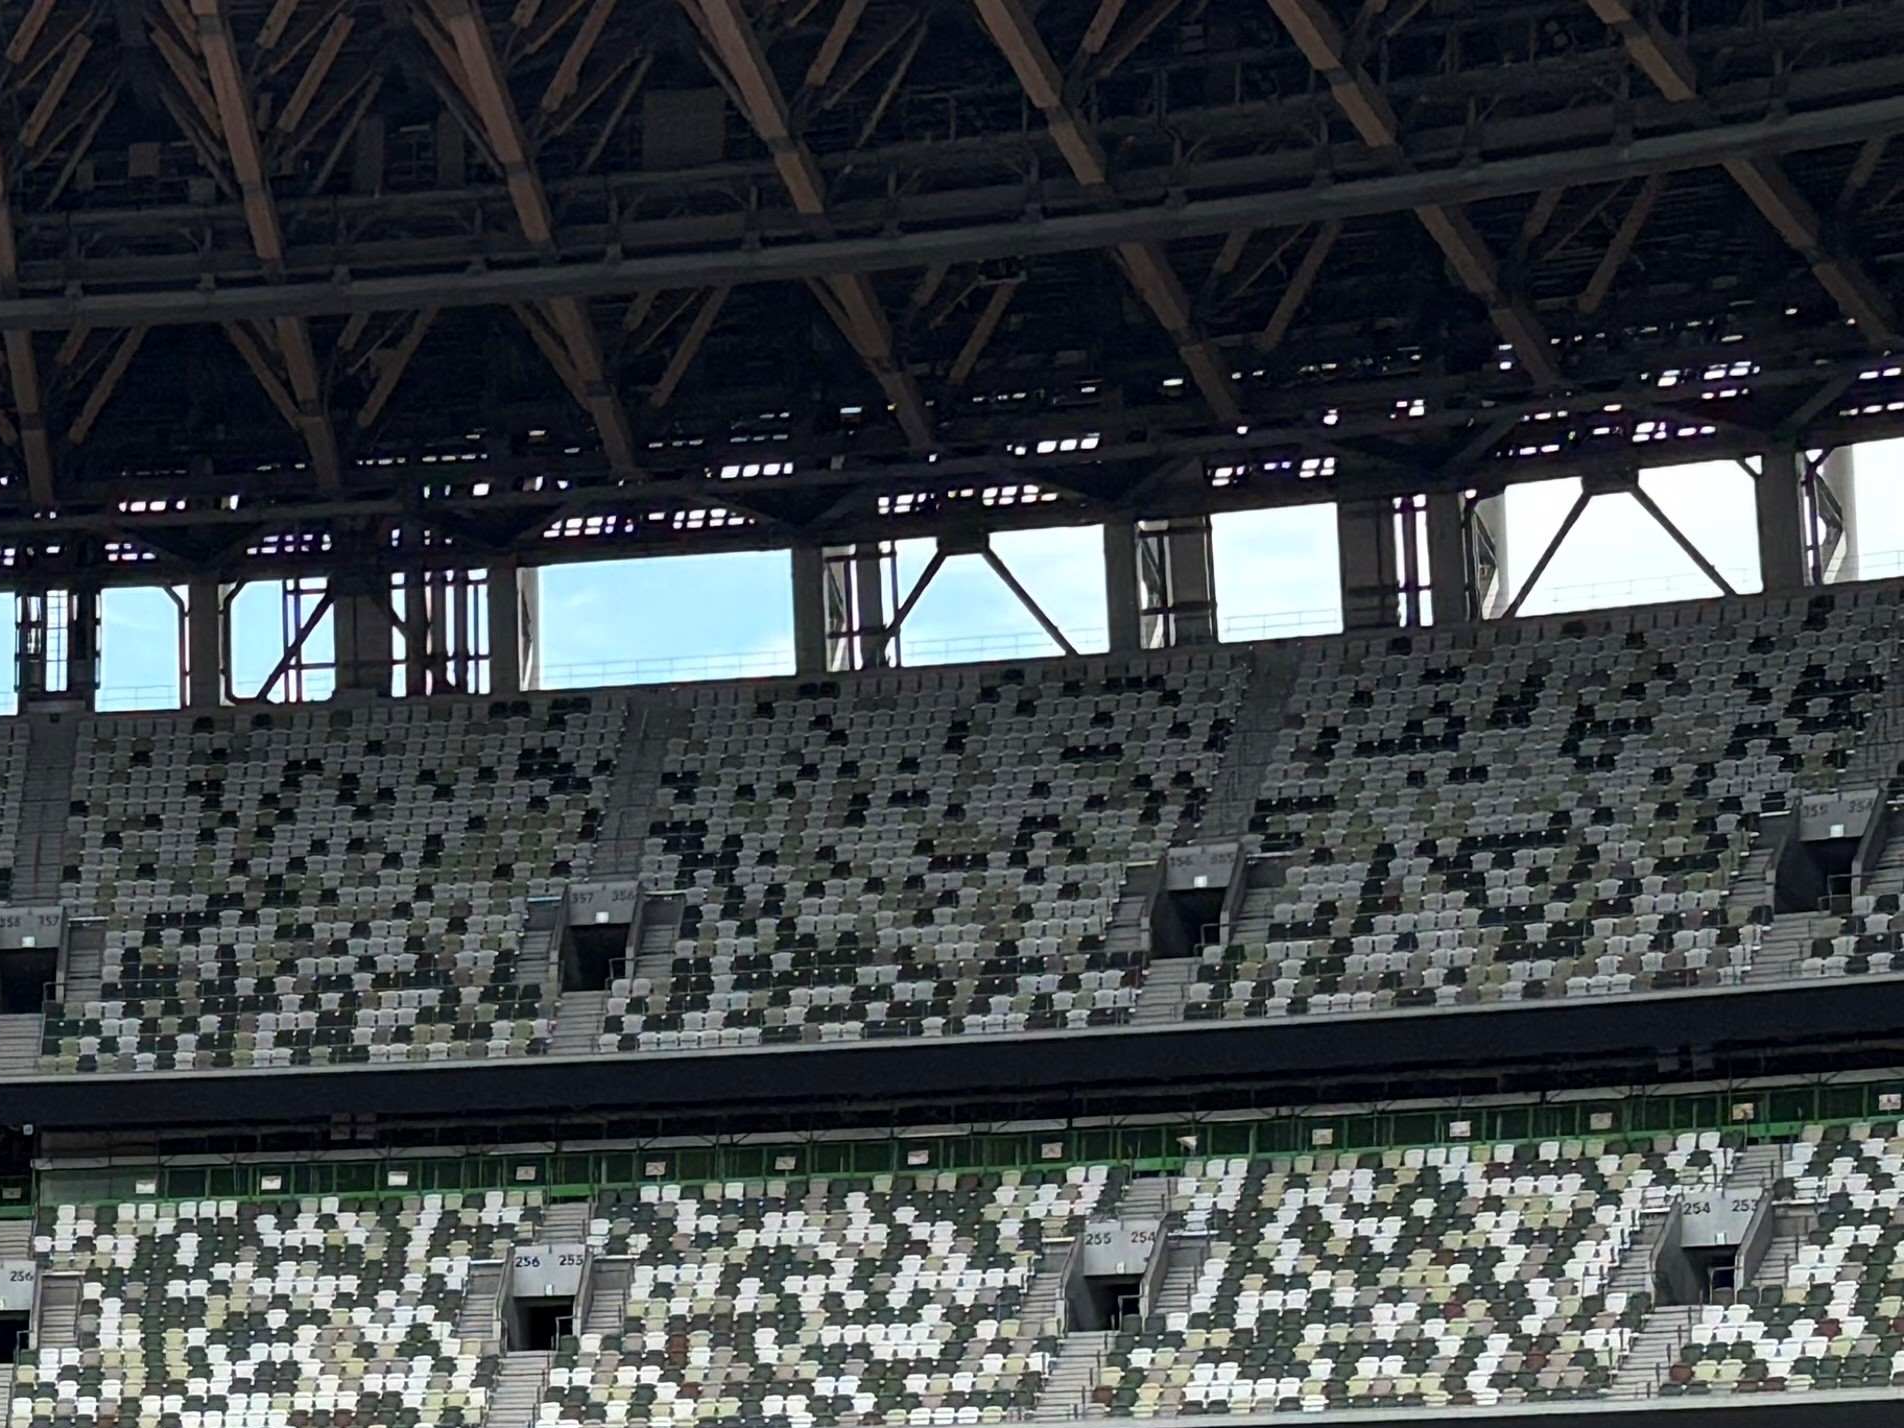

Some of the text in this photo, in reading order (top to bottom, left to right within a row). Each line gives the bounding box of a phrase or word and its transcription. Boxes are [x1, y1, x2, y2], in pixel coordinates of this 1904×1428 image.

[1683, 1202, 1711, 1216] 254
[1086, 1231, 1156, 1246] 255 254
[516, 1255, 584, 1268] 256 255
[10, 1271, 34, 1282] 256
